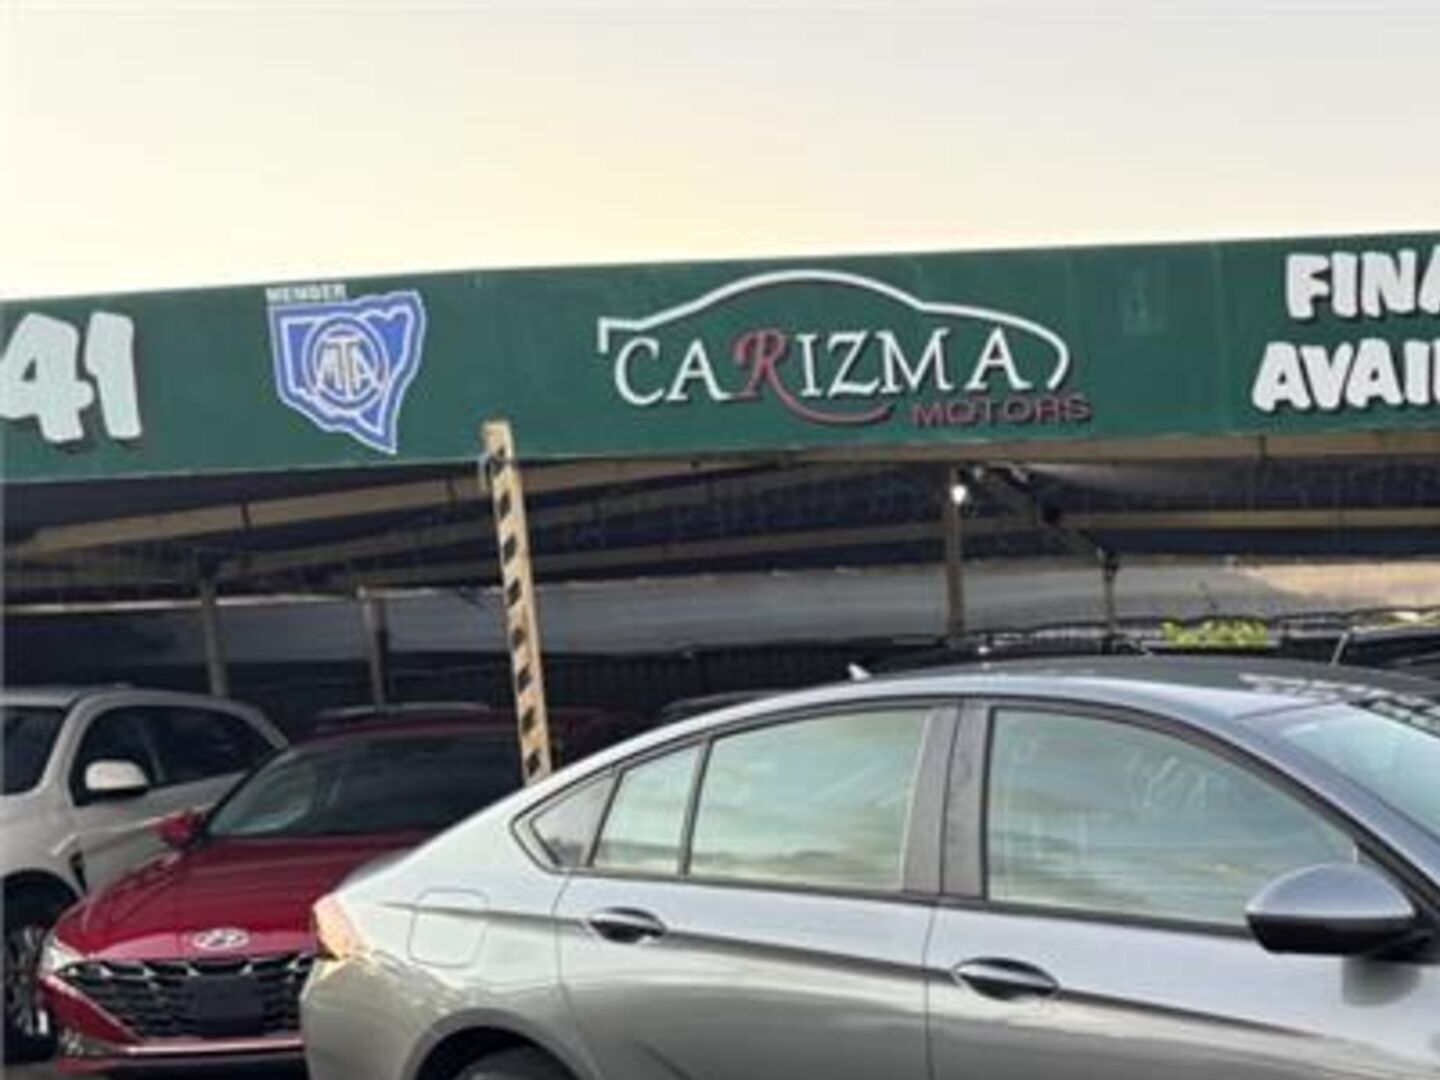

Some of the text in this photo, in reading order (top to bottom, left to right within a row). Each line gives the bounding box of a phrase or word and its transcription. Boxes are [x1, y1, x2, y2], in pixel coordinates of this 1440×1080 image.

[0, 312, 142, 441] 41
[613, 327, 1034, 422] CARIZMA
[911, 392, 1092, 428] MOTORS
